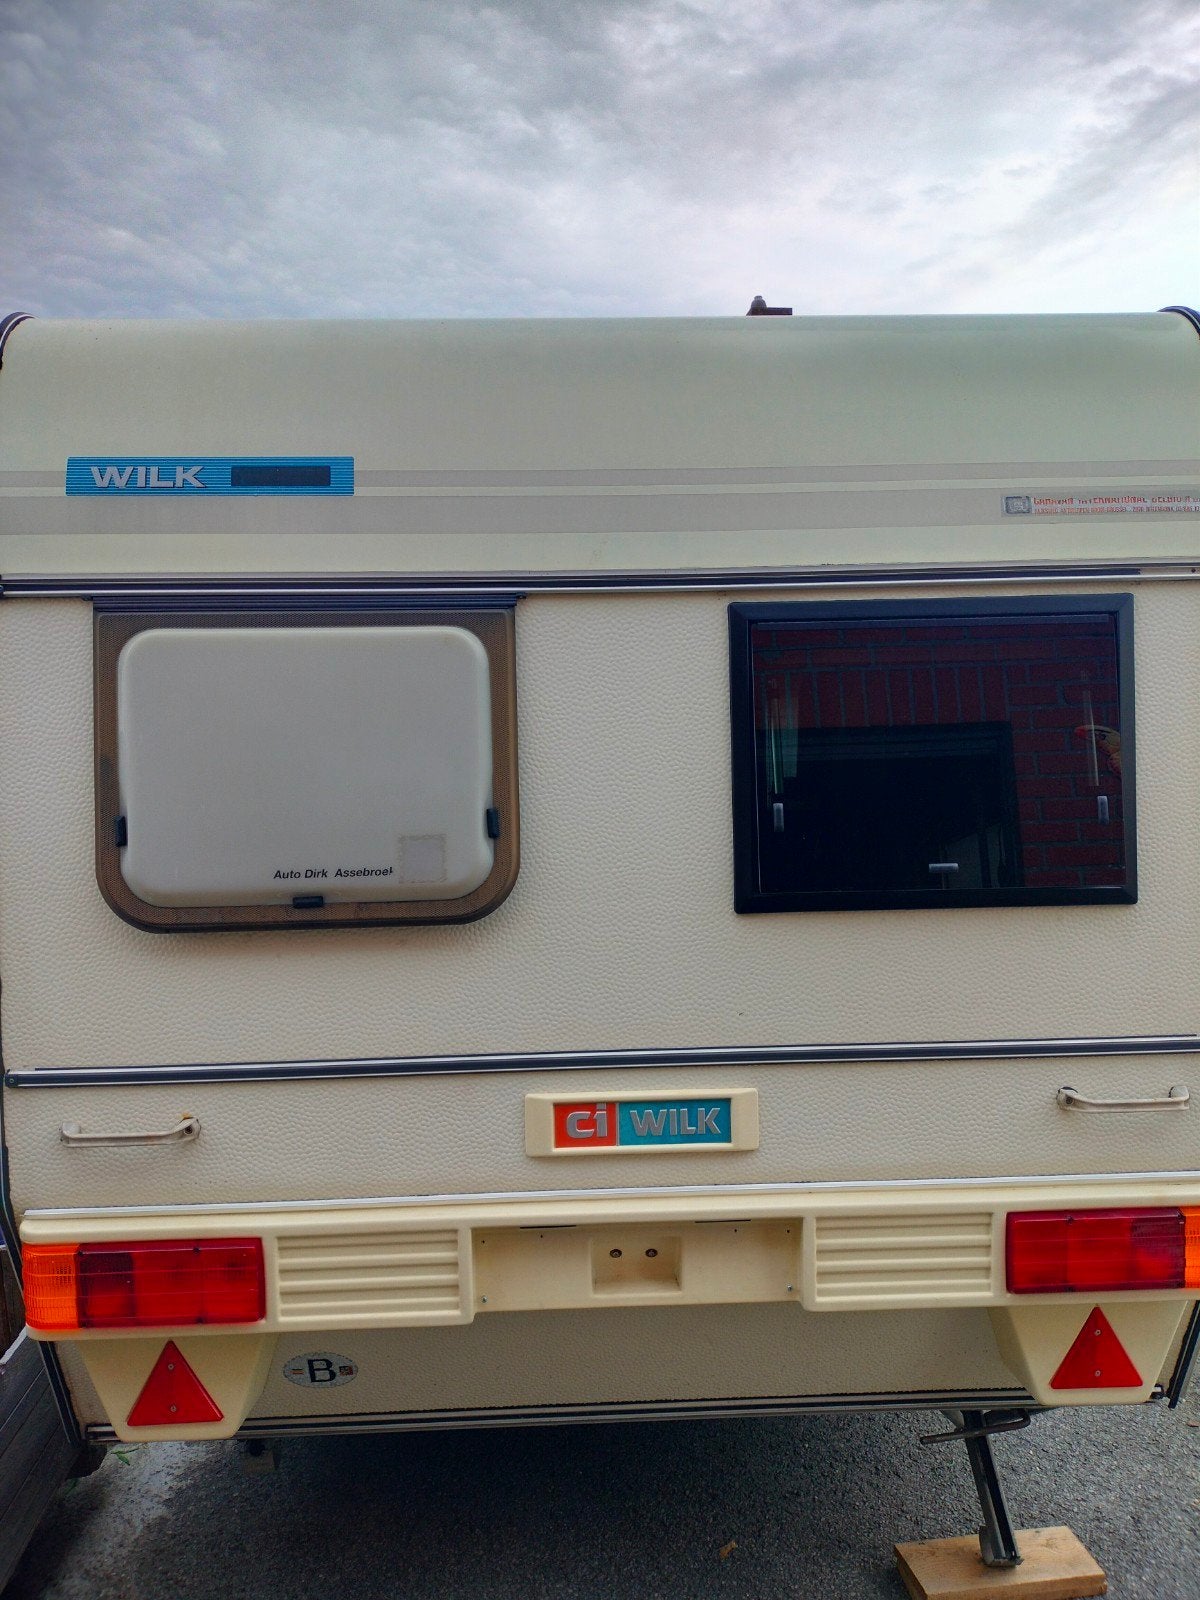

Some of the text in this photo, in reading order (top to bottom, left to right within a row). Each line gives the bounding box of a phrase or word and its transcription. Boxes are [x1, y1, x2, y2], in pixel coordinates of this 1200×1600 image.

[90, 465, 206, 488] WILK
[273, 870, 301, 879] Auto
[304, 869, 328, 878] Dirk
[629, 1108, 721, 1137] WILK
[308, 1359, 336, 1382] B
